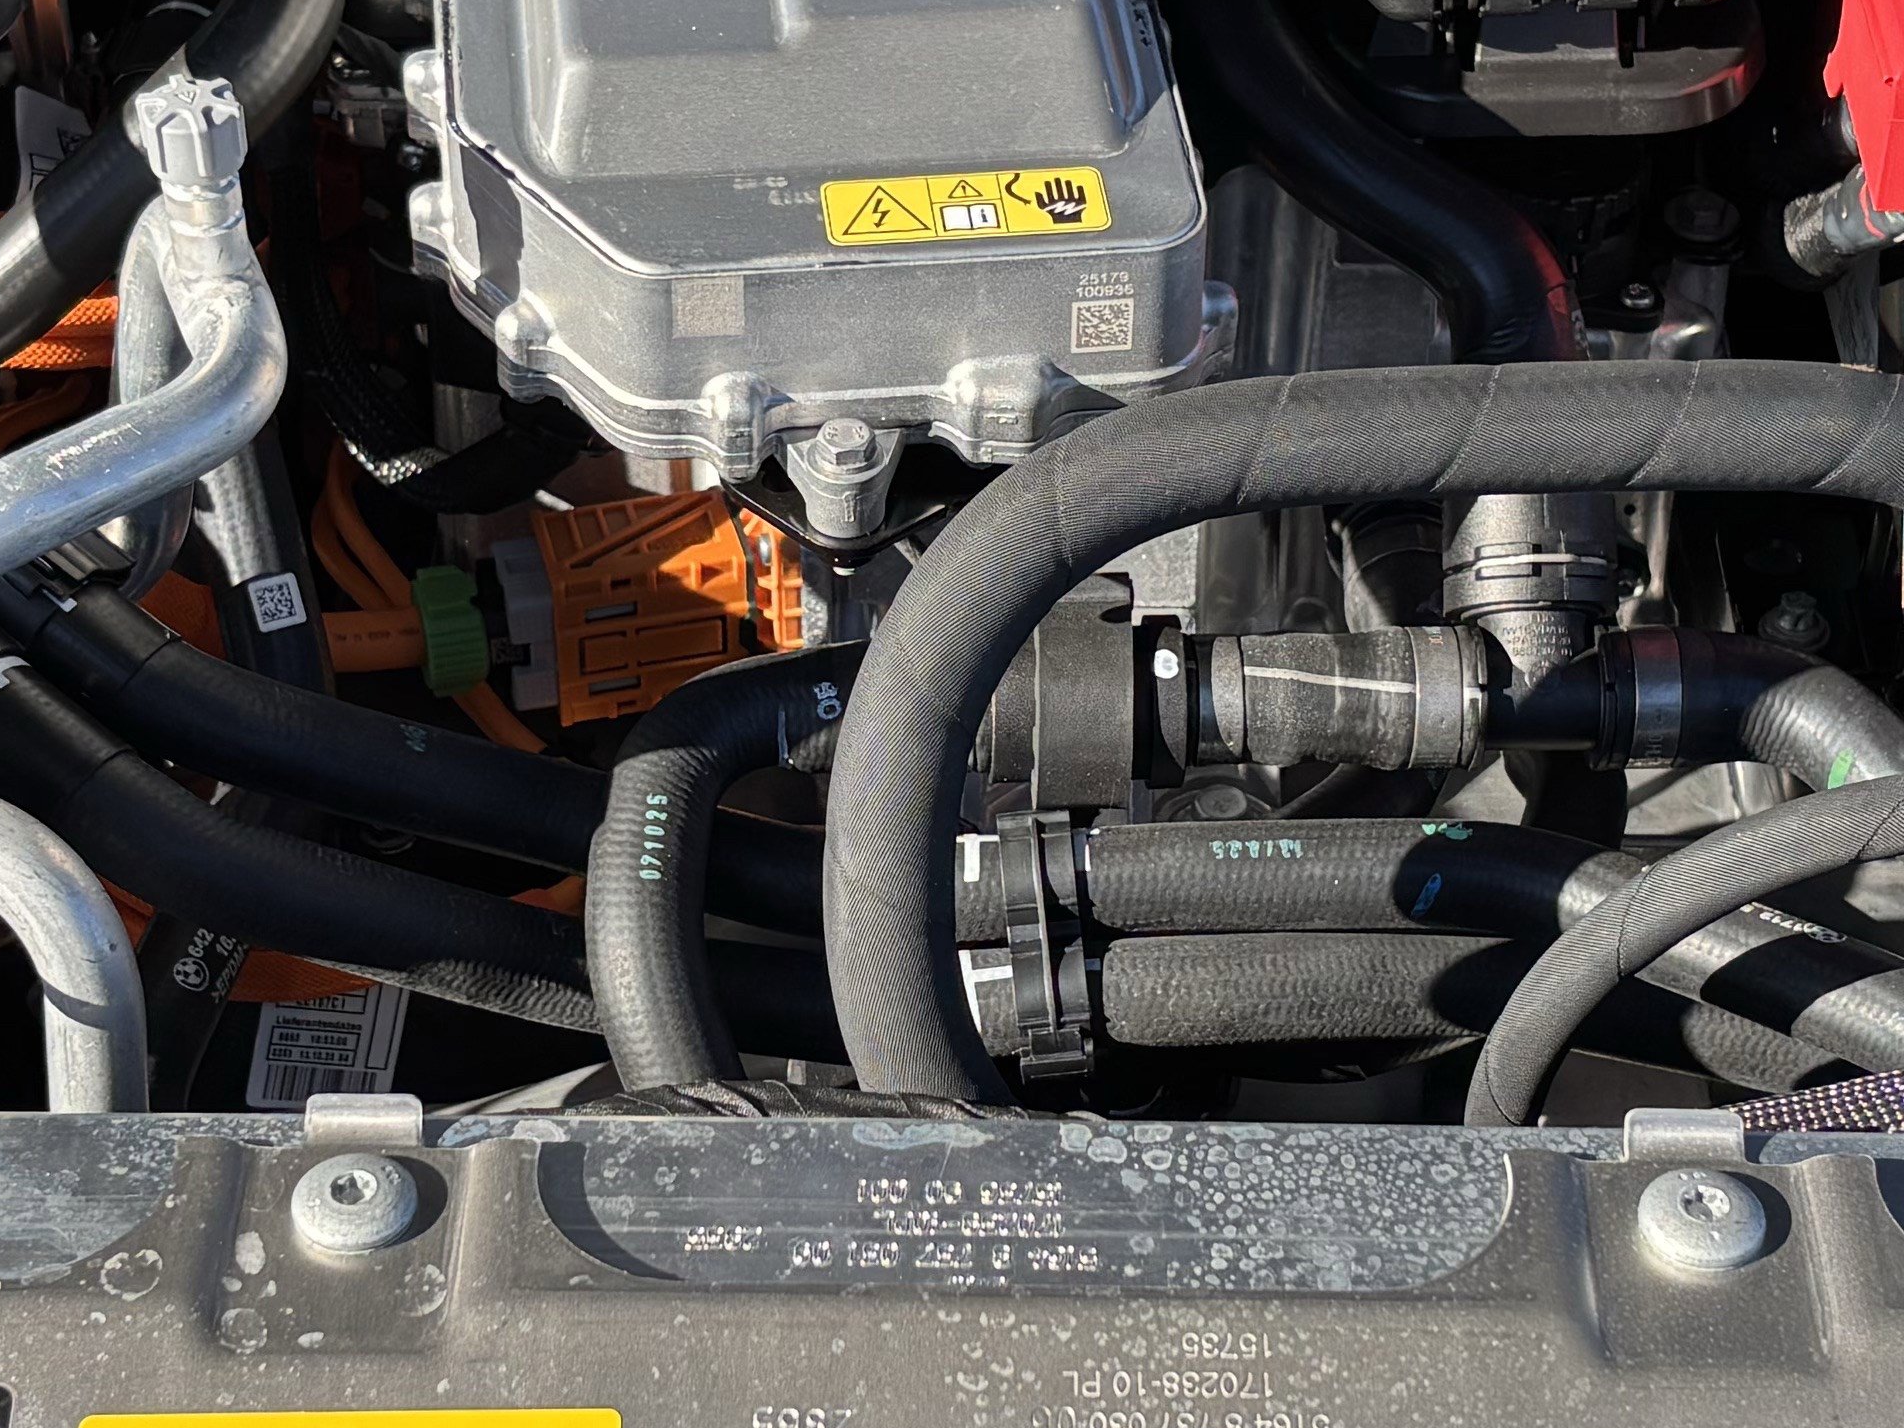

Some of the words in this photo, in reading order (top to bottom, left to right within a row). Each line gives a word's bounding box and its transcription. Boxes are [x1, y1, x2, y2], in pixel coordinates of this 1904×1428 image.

[1080, 272, 1129, 286] 25179
[1181, 1332, 1271, 1358] 15735
[1061, 1369, 1102, 1397] PL
[1111, 1369, 1274, 1398] 170238-10
